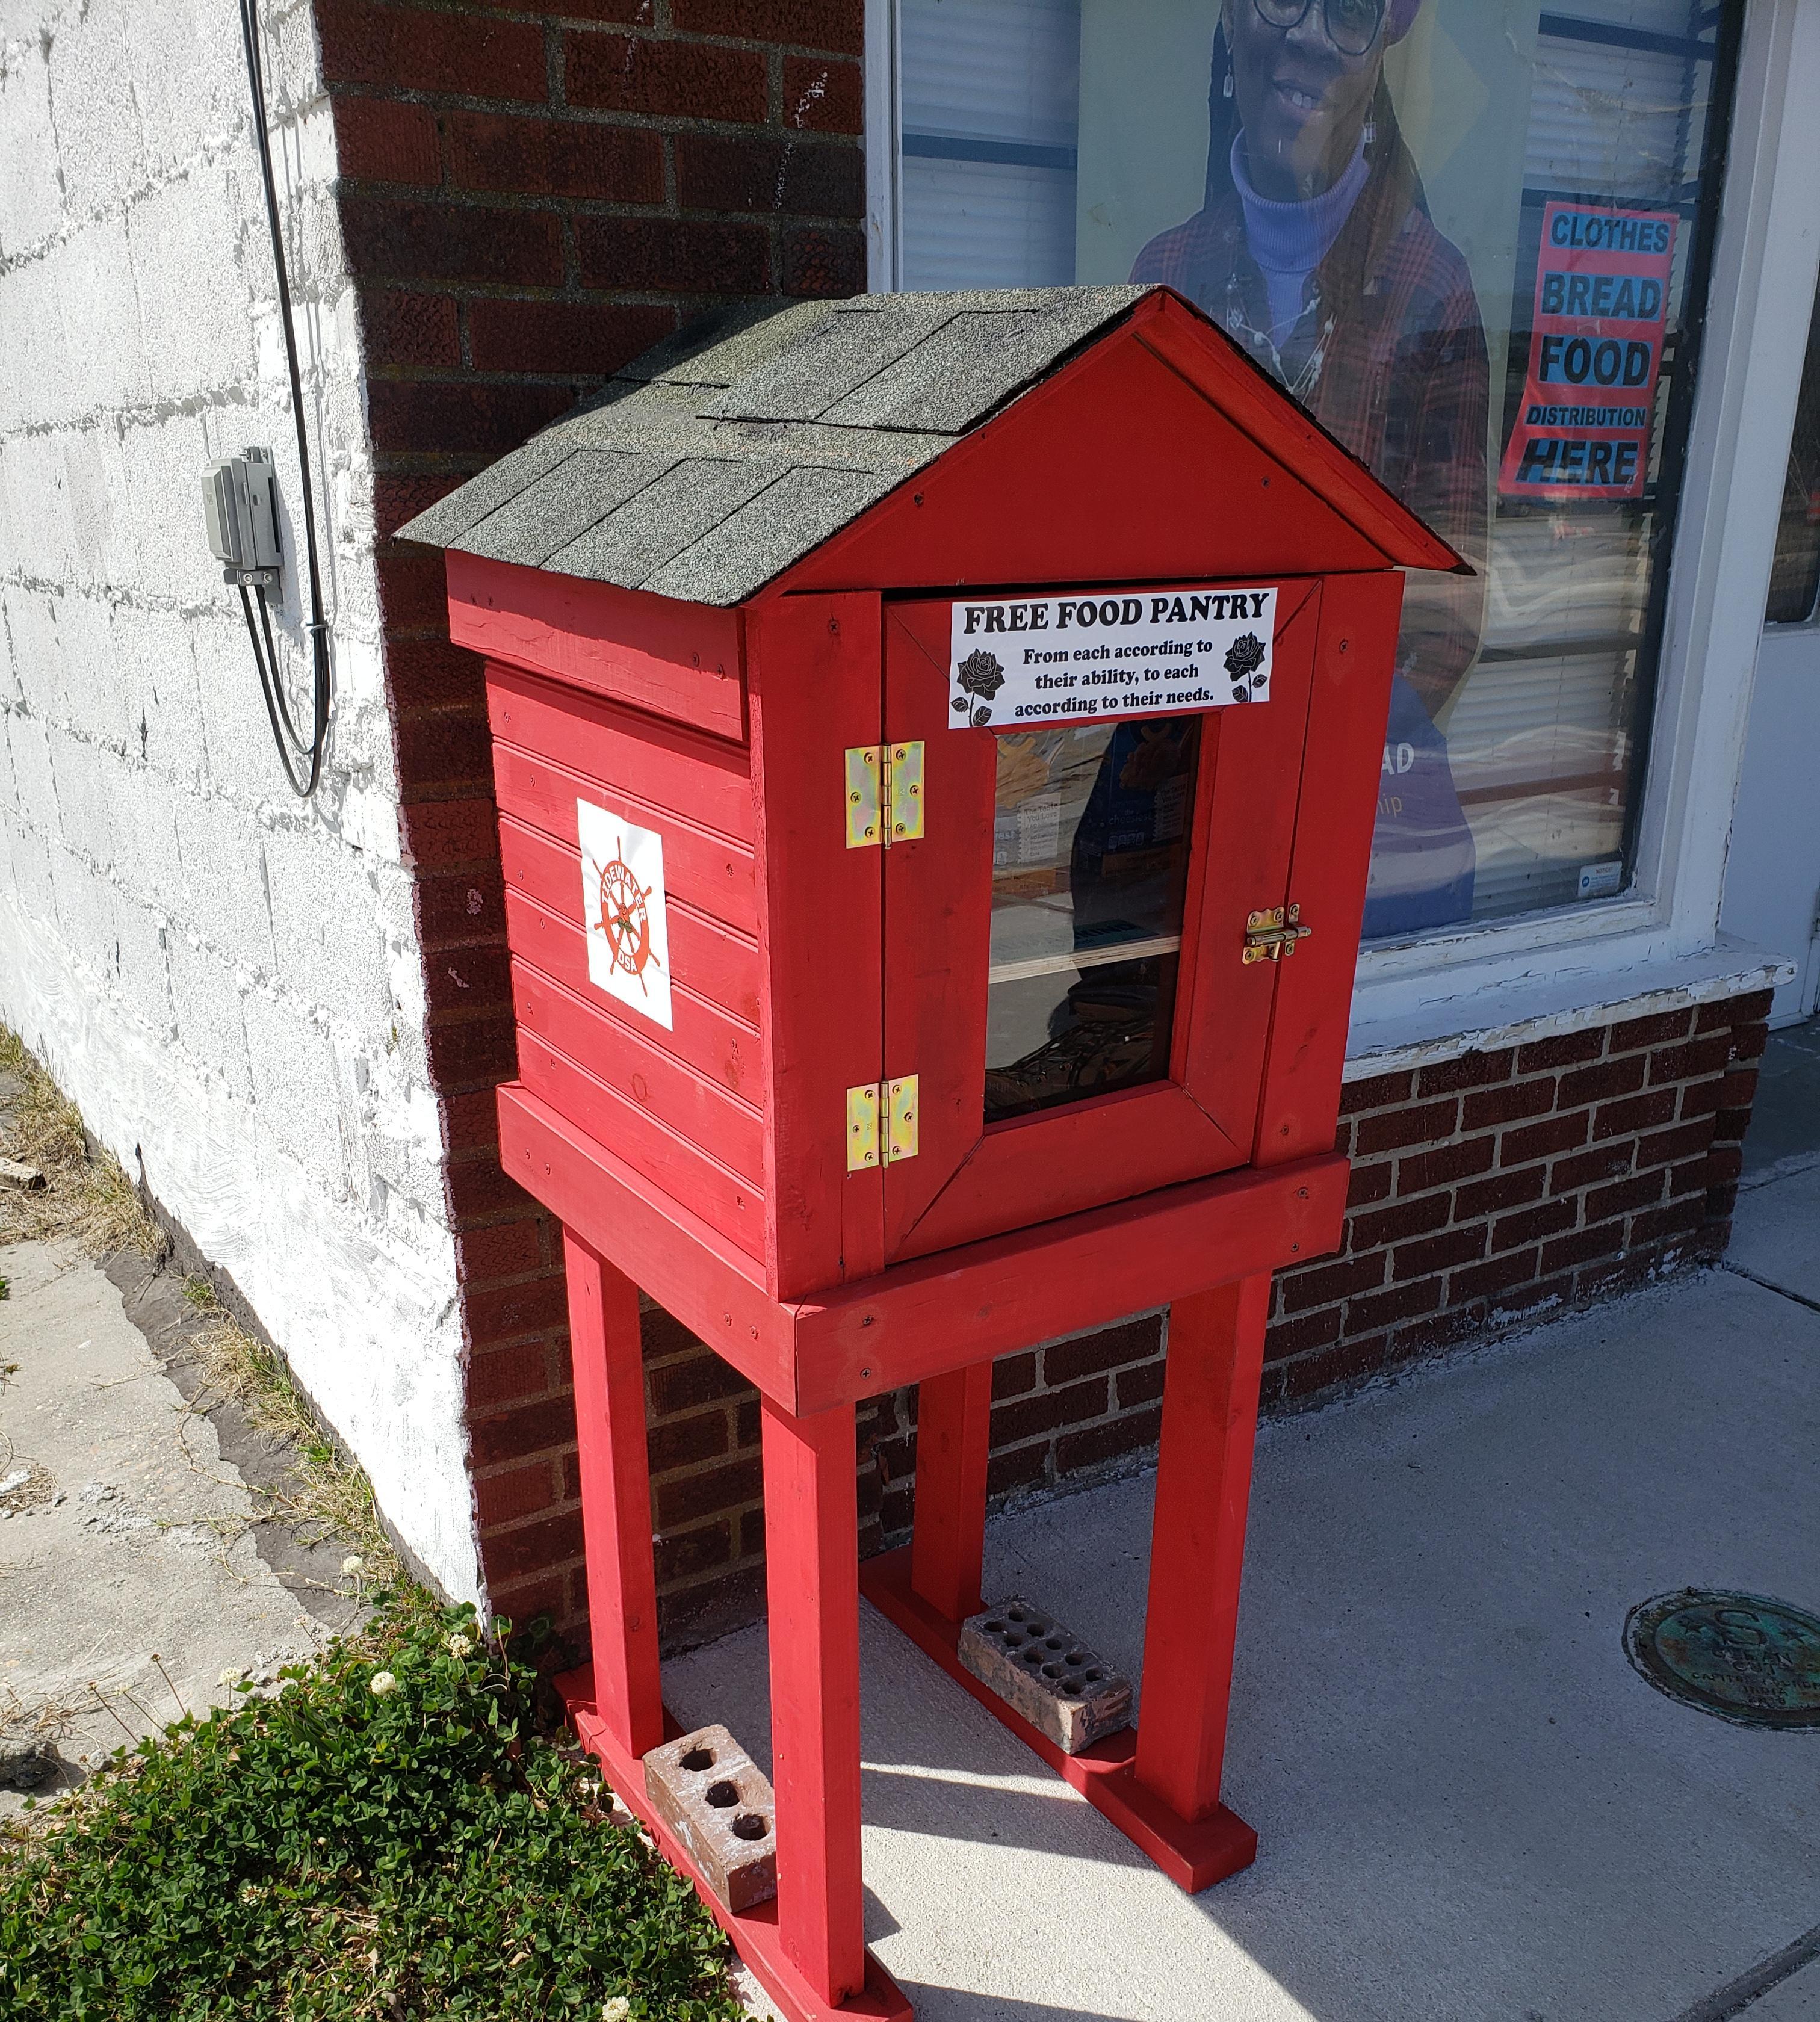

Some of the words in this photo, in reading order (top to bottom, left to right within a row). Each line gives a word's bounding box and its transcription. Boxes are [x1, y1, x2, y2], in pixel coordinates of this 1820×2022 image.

[1550, 214, 1670, 253] CLOTHES
[1541, 273, 1661, 319] BREAD
[1538, 335, 1651, 386] FOOD
[1526, 406, 1646, 427] DISTRIBUTION
[1517, 439, 1639, 484] HERE
[963, 602, 1049, 635] FREE
[1055, 598, 1142, 629] FOOD
[1150, 593, 1270, 624] PANTRY
[1023, 648, 1069, 664] From
[1072, 644, 1110, 661] each
[1114, 640, 1193, 660] according
[1196, 638, 1213, 653] to
[1035, 672, 1077, 690] their
[1081, 667, 1139, 687] ability,
[1143, 666, 1160, 682] to
[1163, 663, 1199, 679] each
[1014, 696, 1098, 717] according
[1101, 693, 1118, 710] to
[1121, 691, 1162, 708] their
[1166, 687, 1215, 703] needs.
[1041, 811, 1057, 820] Love
[602, 865, 646, 921] TIDEWATER
[617, 948, 638, 972] DSA
